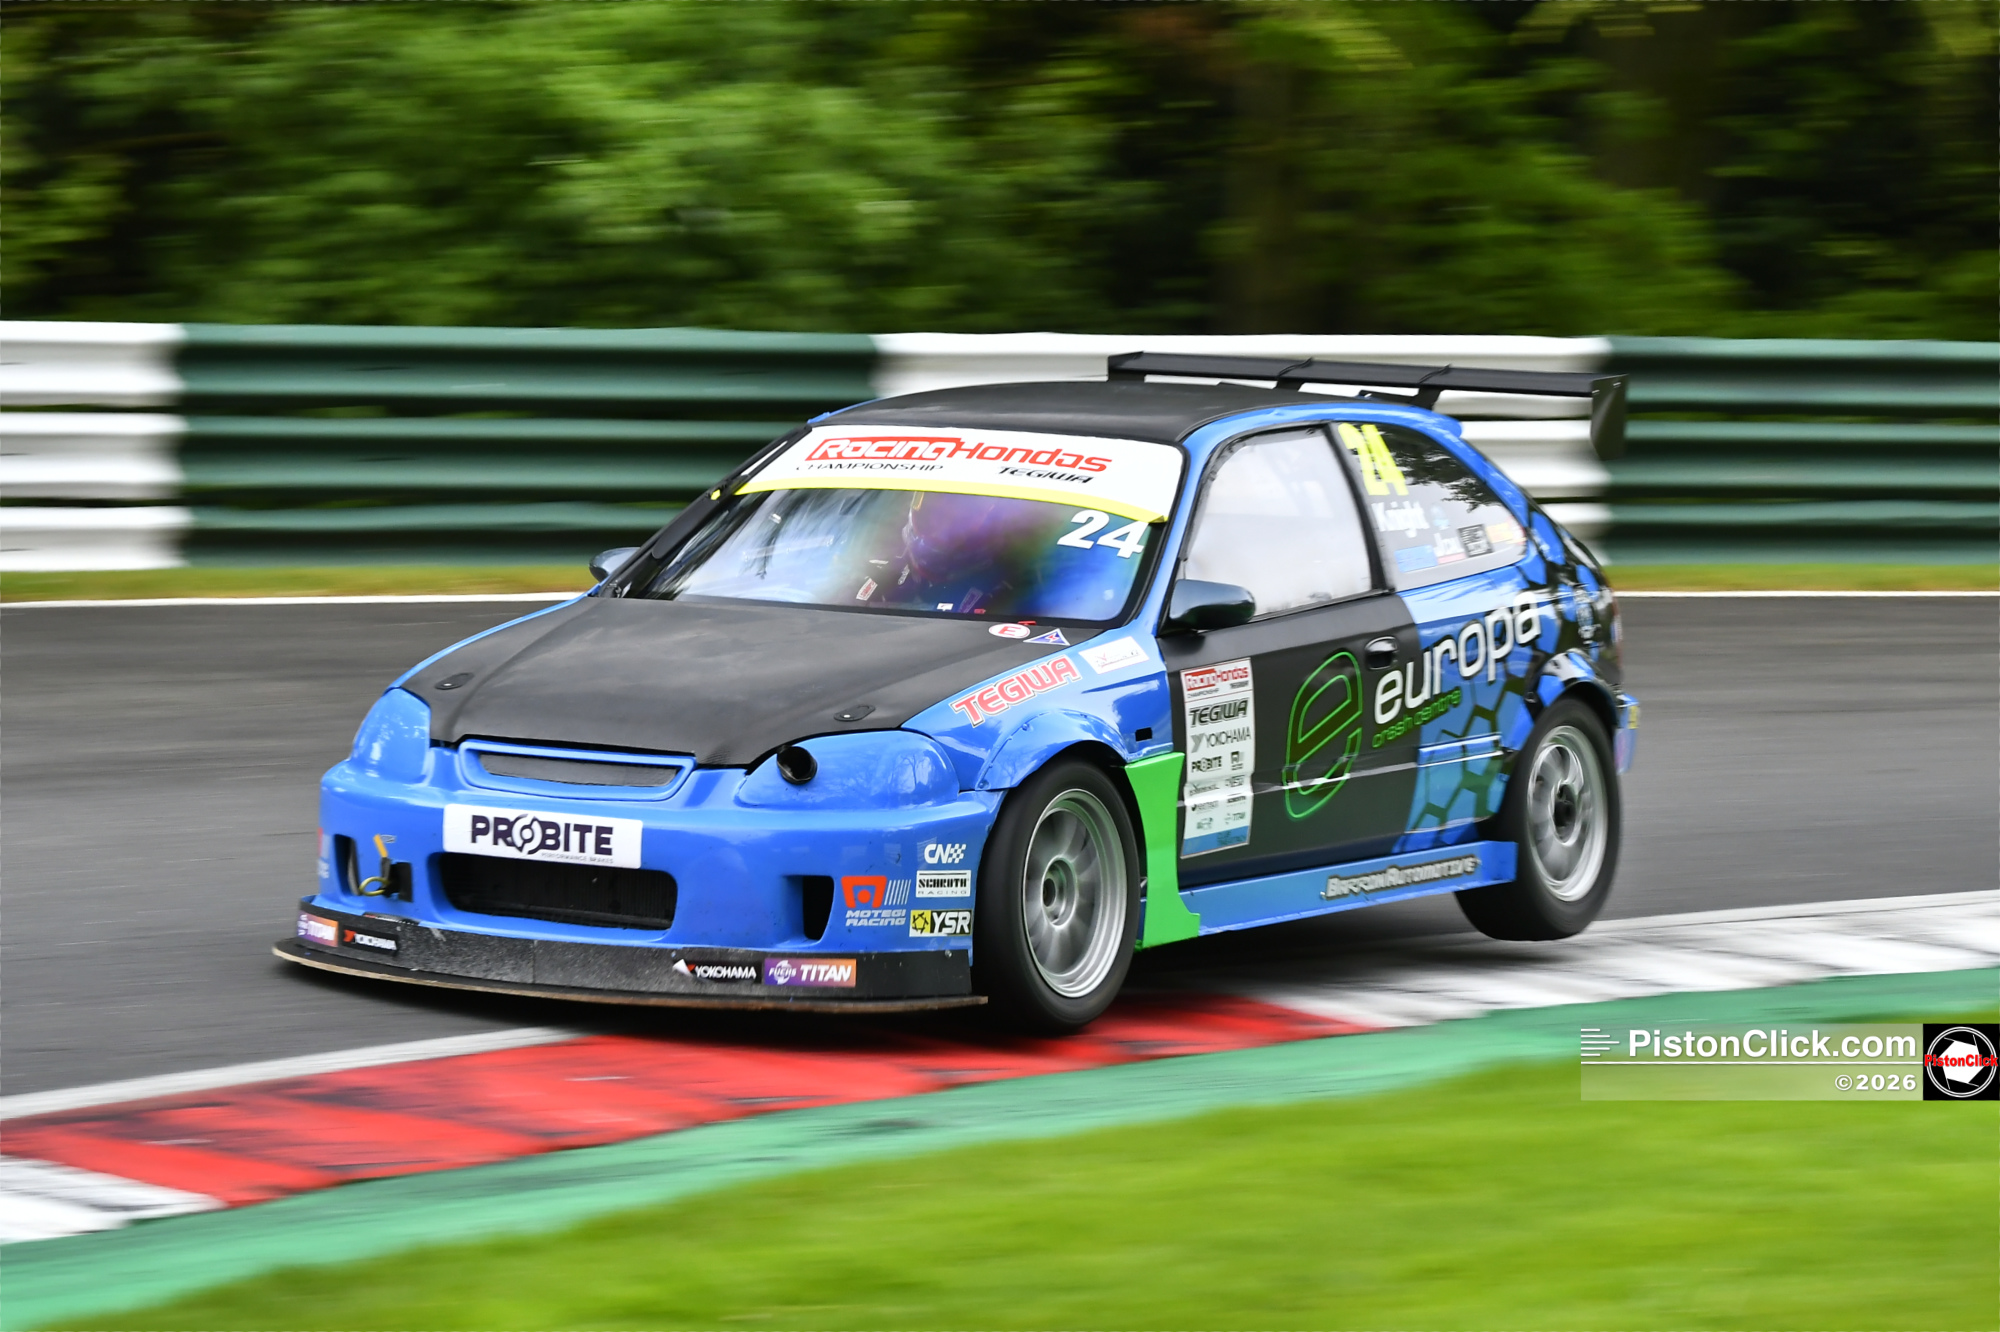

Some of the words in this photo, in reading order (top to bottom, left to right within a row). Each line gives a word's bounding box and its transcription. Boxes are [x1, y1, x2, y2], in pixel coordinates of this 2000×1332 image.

[1338, 423, 1409, 496] 24
[1057, 510, 1146, 558] 24
[1374, 591, 1542, 724] europa
[950, 655, 1081, 727] TEGIWA
[1188, 698, 1249, 727] TEGIWA
[1372, 705, 1413, 749] crash
[1414, 687, 1462, 726] centre
[1204, 727, 1251, 749] YOKOHAMA
[471, 814, 614, 856] PROBITE
[918, 878, 967, 888] SCHROTH
[846, 909, 906, 918] MOTEGI
[846, 917, 906, 927] RACING
[932, 911, 971, 934] YSR
[695, 965, 757, 980] YOKOHAMA
[800, 964, 852, 982] TITAN
